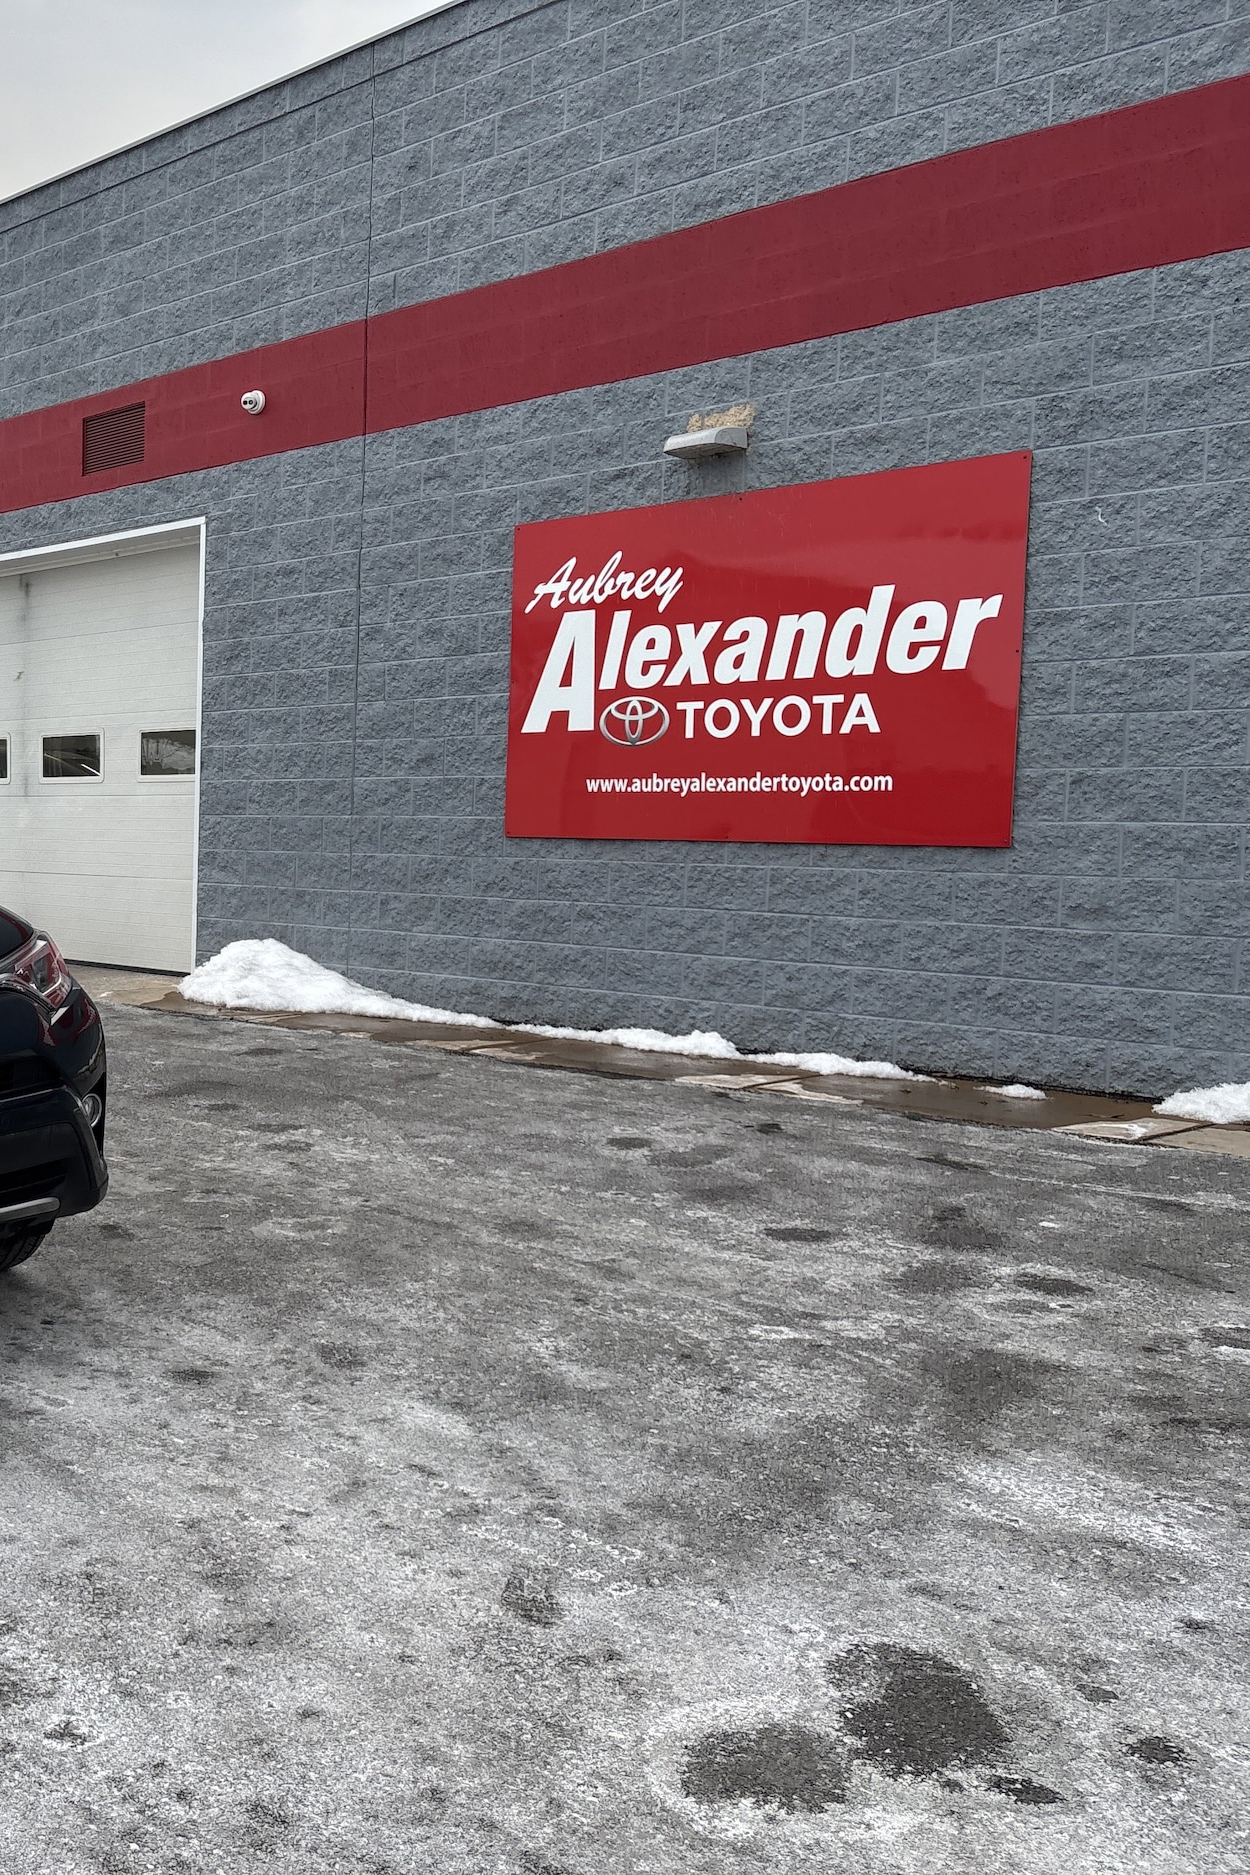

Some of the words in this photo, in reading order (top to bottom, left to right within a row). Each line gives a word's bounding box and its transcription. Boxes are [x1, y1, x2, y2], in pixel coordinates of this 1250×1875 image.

[524, 550, 684, 614] Aubrey
[520, 584, 1004, 734] Alexander
[676, 692, 881, 739] TOYOTA
[585, 771, 893, 798] www.aubreyalexandertoyota.com
